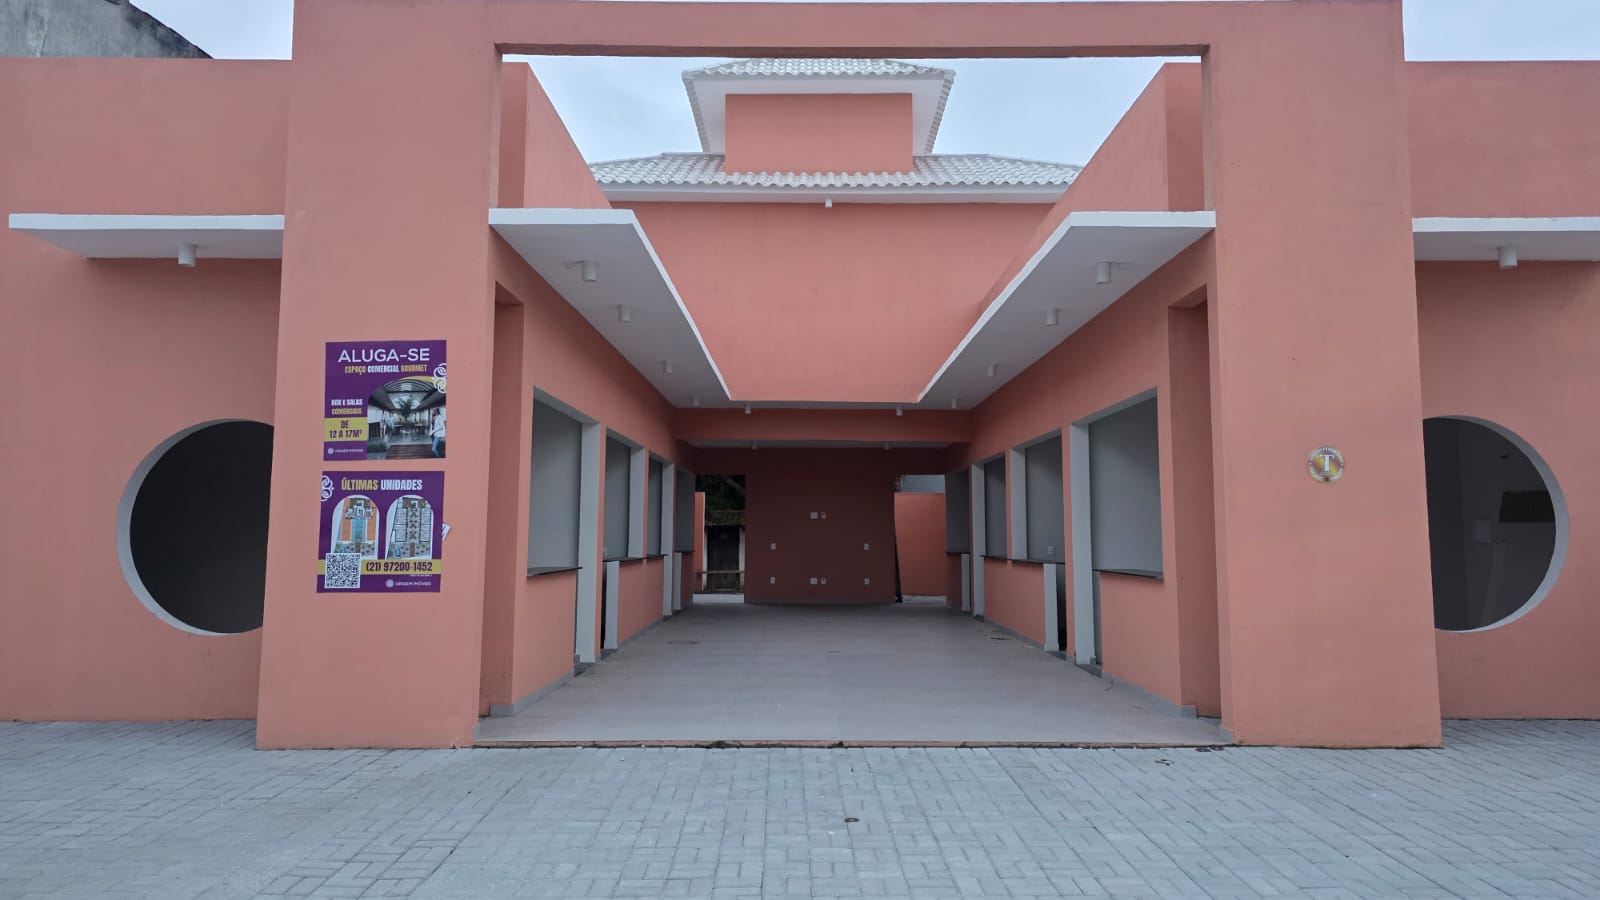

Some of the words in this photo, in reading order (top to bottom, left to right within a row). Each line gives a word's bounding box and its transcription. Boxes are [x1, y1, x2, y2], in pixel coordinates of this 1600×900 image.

[337, 348, 430, 362] ALUGA-SE
[344, 366, 367, 375] ESPAÇO
[1320, 454, 1334, 472] T
[341, 477, 378, 490] ÚLTIMAS
[380, 480, 423, 490] UNIDADES
[366, 562, 381, 572] (21)
[383, 562, 433, 571] 97200-1452
